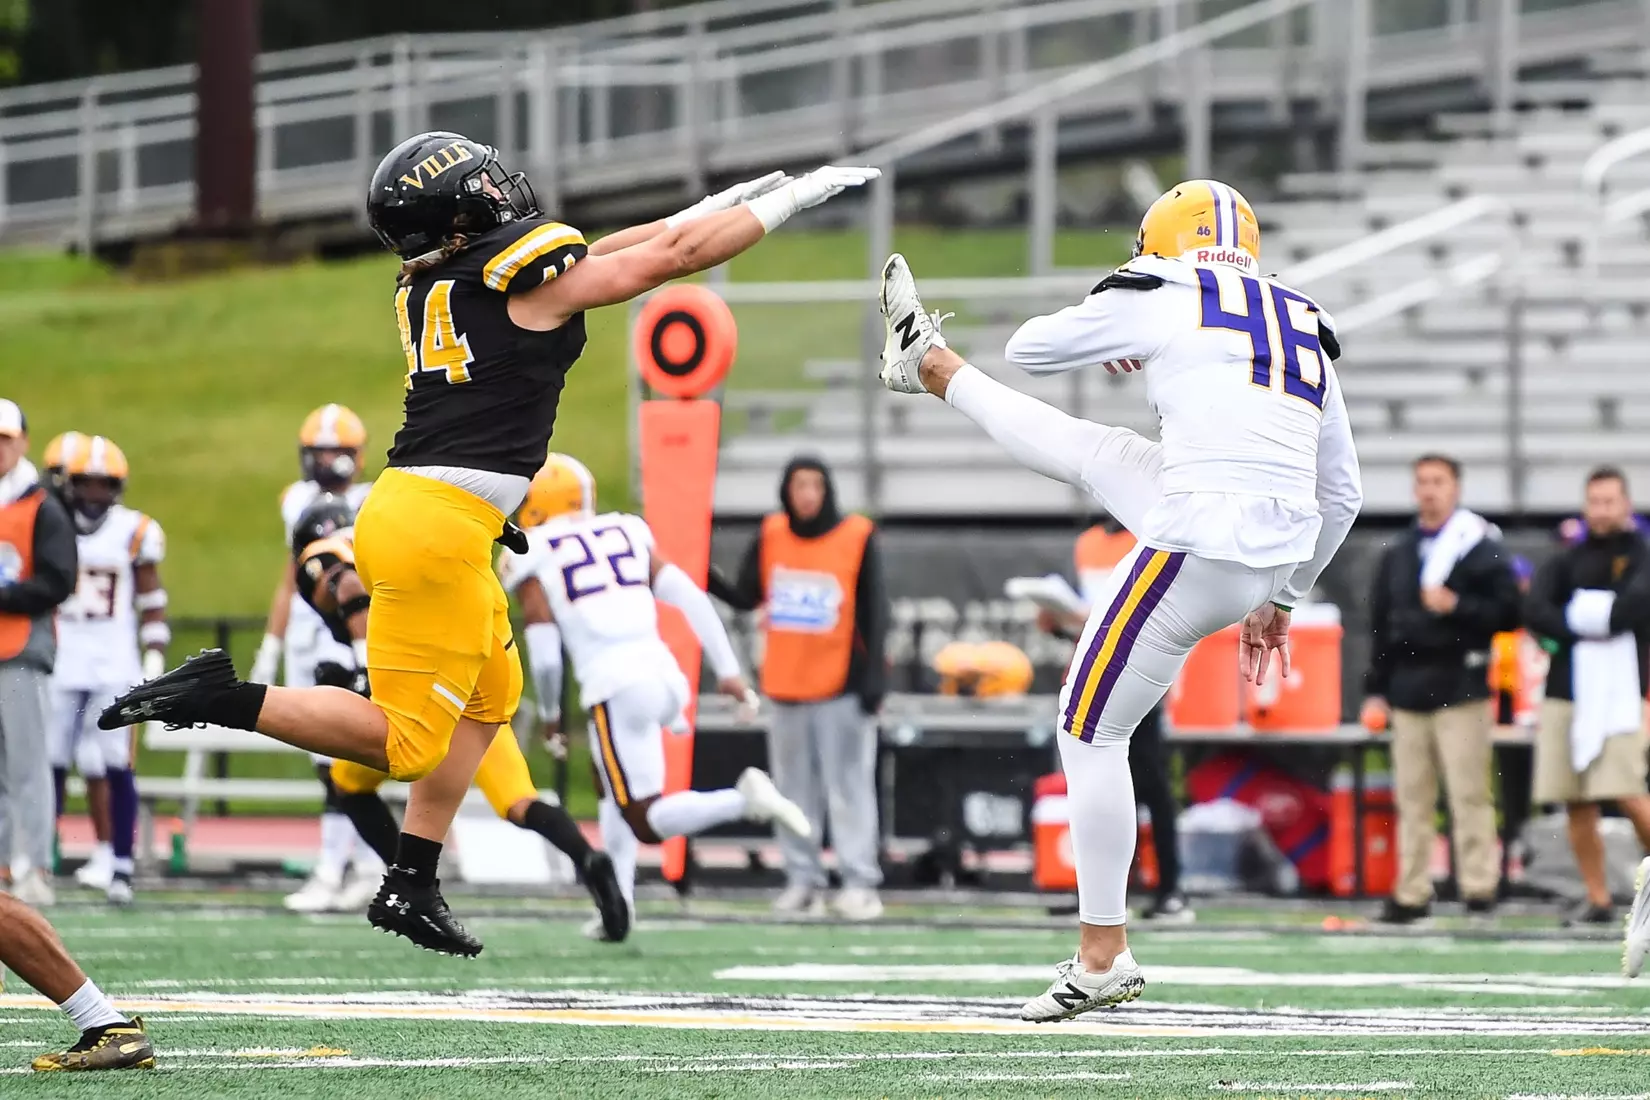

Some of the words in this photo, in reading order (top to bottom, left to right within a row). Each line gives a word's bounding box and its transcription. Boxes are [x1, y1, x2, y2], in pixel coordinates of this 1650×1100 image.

[399, 141, 474, 190] VILLE
[1196, 226, 1211, 236] 46
[1197, 250, 1251, 269] Riddell
[1194, 267, 1327, 416] 46
[548, 525, 651, 602] 22
